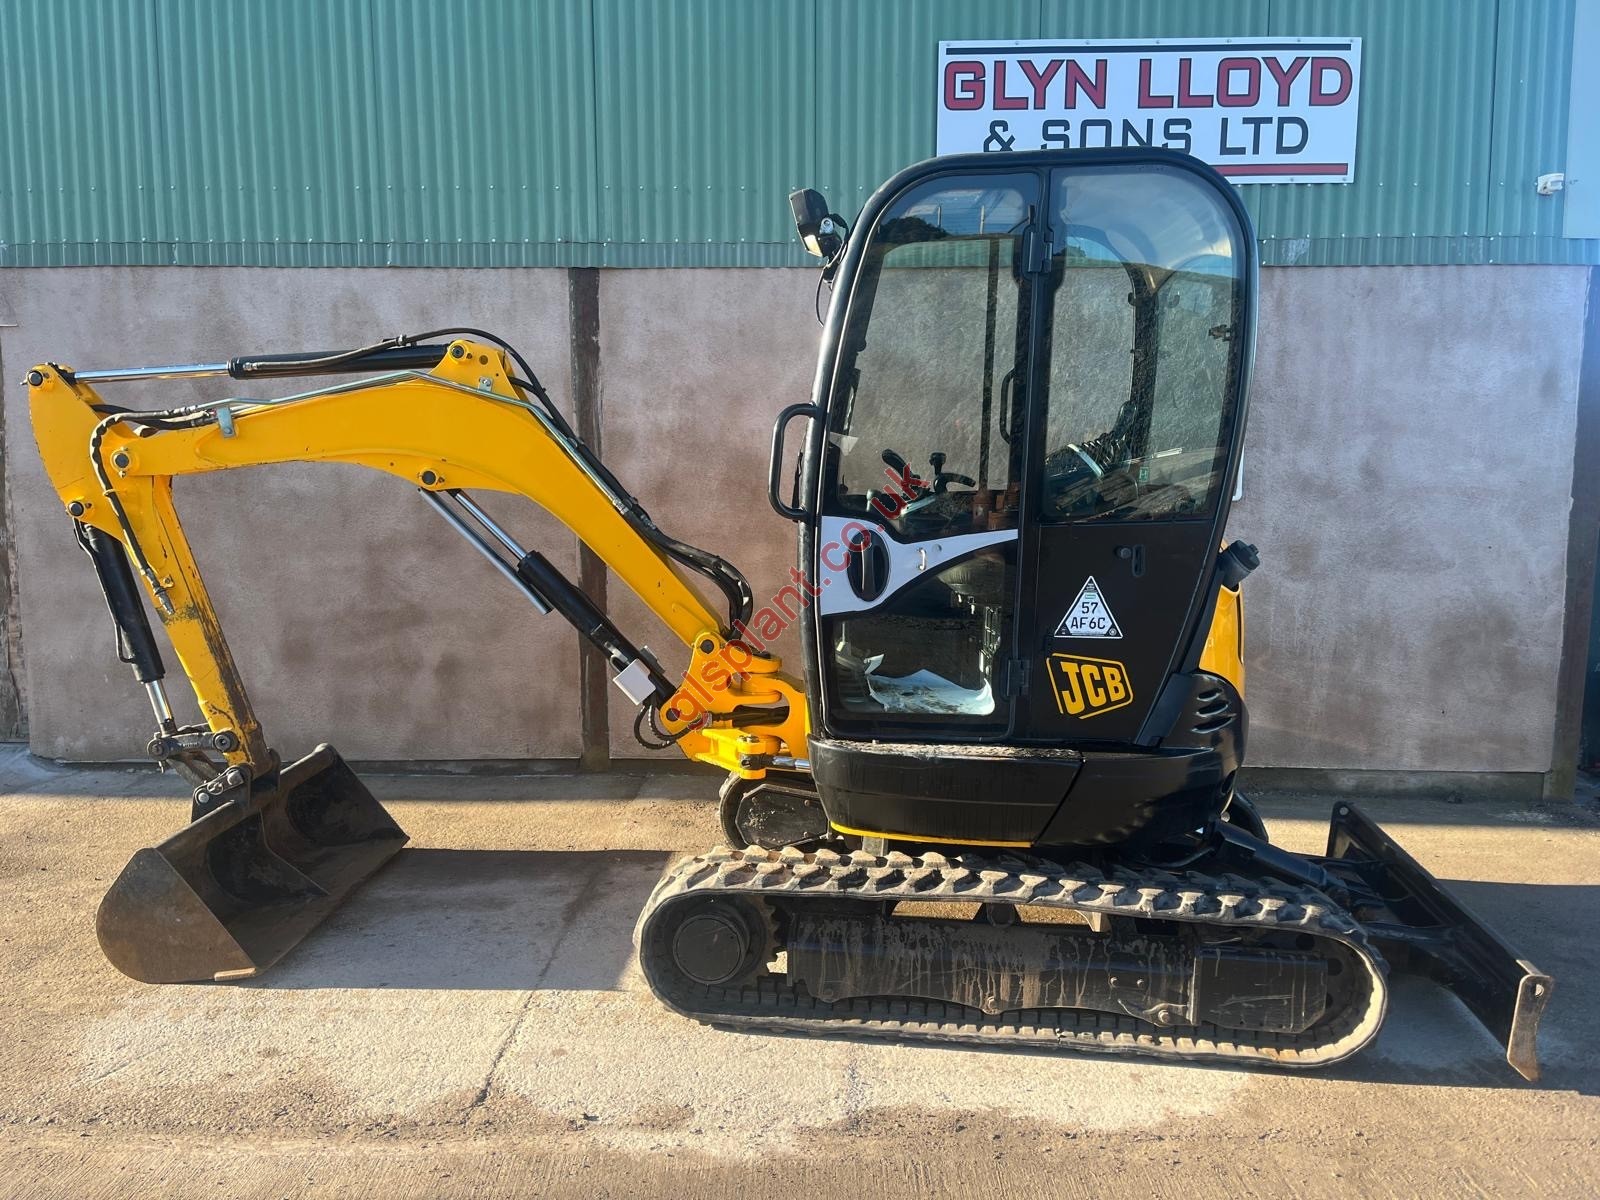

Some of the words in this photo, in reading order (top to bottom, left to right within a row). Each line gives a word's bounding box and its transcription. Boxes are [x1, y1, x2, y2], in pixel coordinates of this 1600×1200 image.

[944, 59, 1107, 111] GLYN
[1138, 57, 1353, 109] LLOYD
[983, 120, 1016, 152] &
[1040, 118, 1192, 154] SONS
[1219, 116, 1309, 156] LTD
[1070, 617, 1106, 630] AF6C
[1081, 602, 1098, 614] 57
[1060, 661, 1126, 714] JCB
